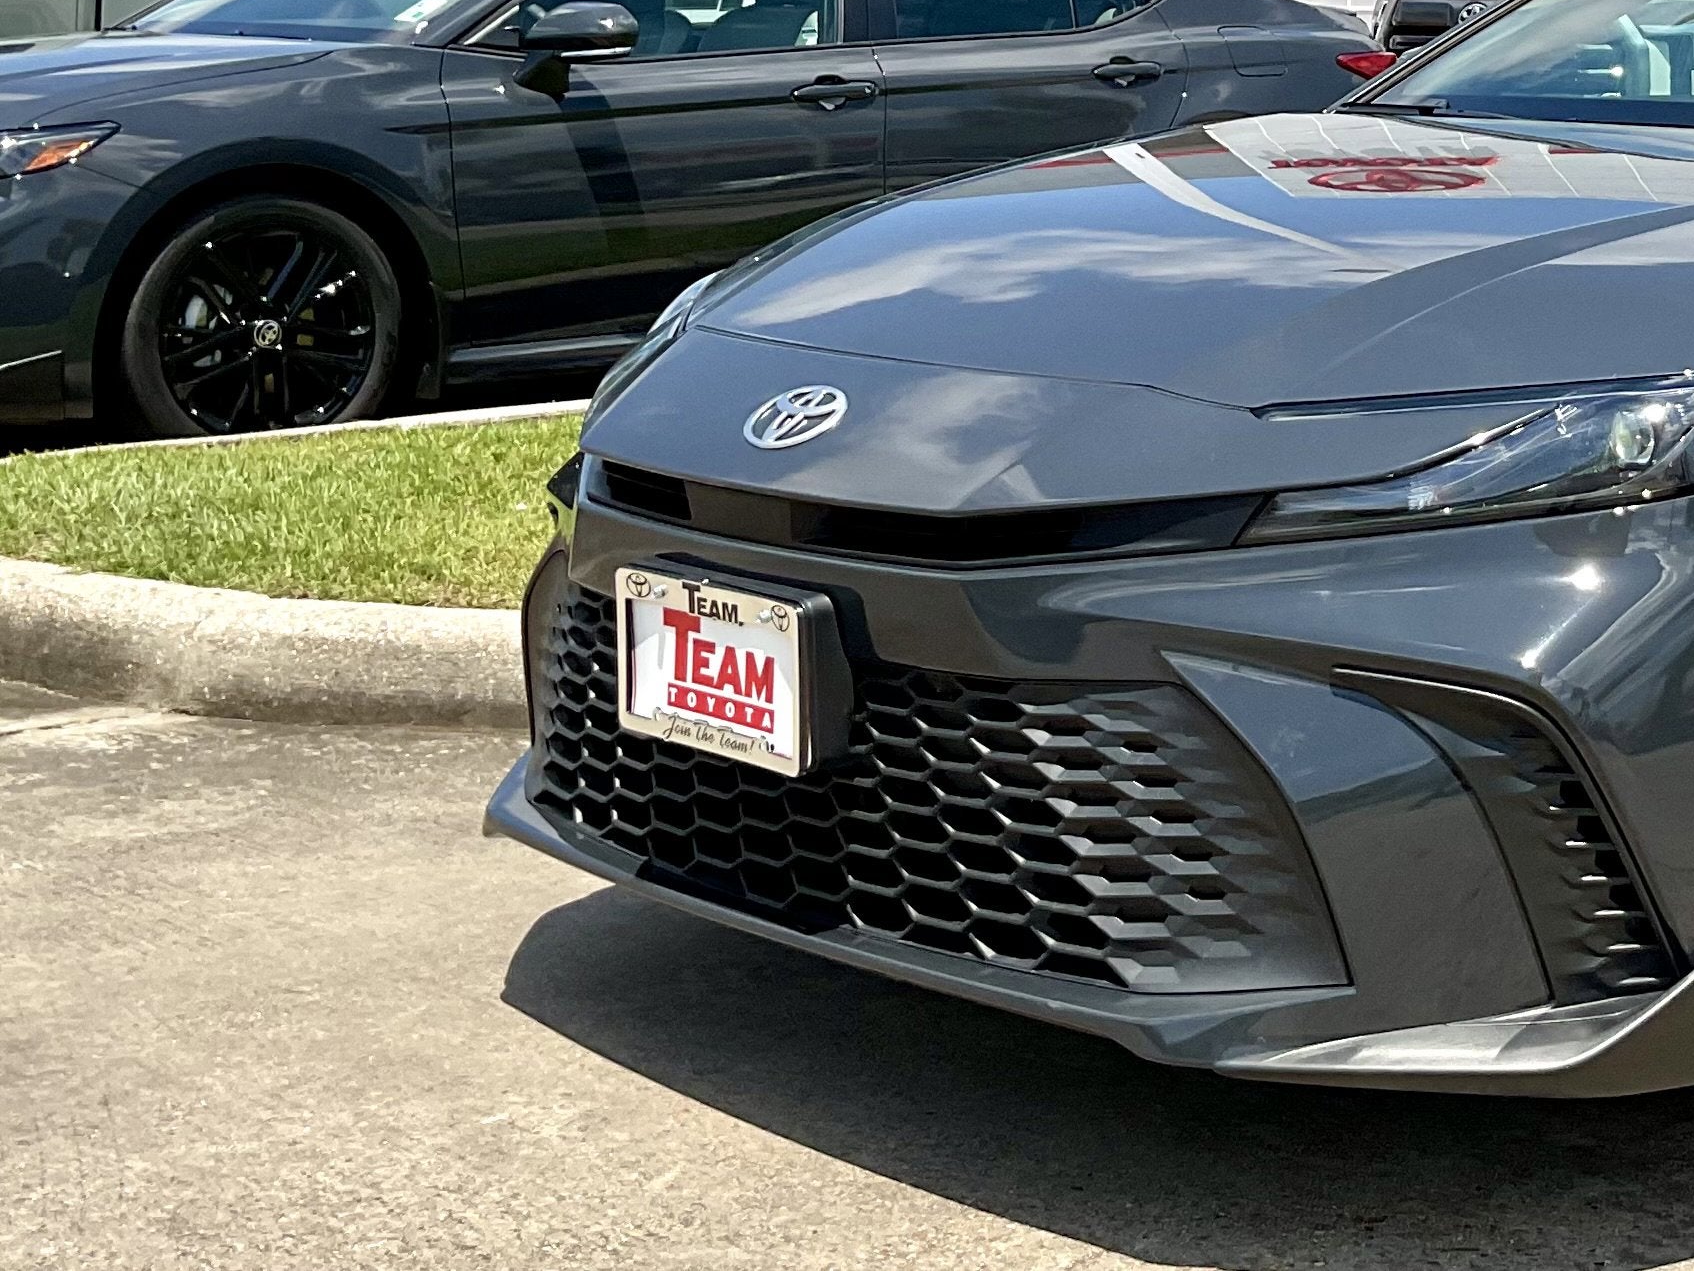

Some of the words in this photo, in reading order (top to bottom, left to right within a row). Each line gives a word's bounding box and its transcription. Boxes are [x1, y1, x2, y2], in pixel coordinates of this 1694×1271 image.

[663, 606, 775, 704] TEAM
[662, 714, 691, 739] Join
[668, 686, 772, 729] TOYOTA
